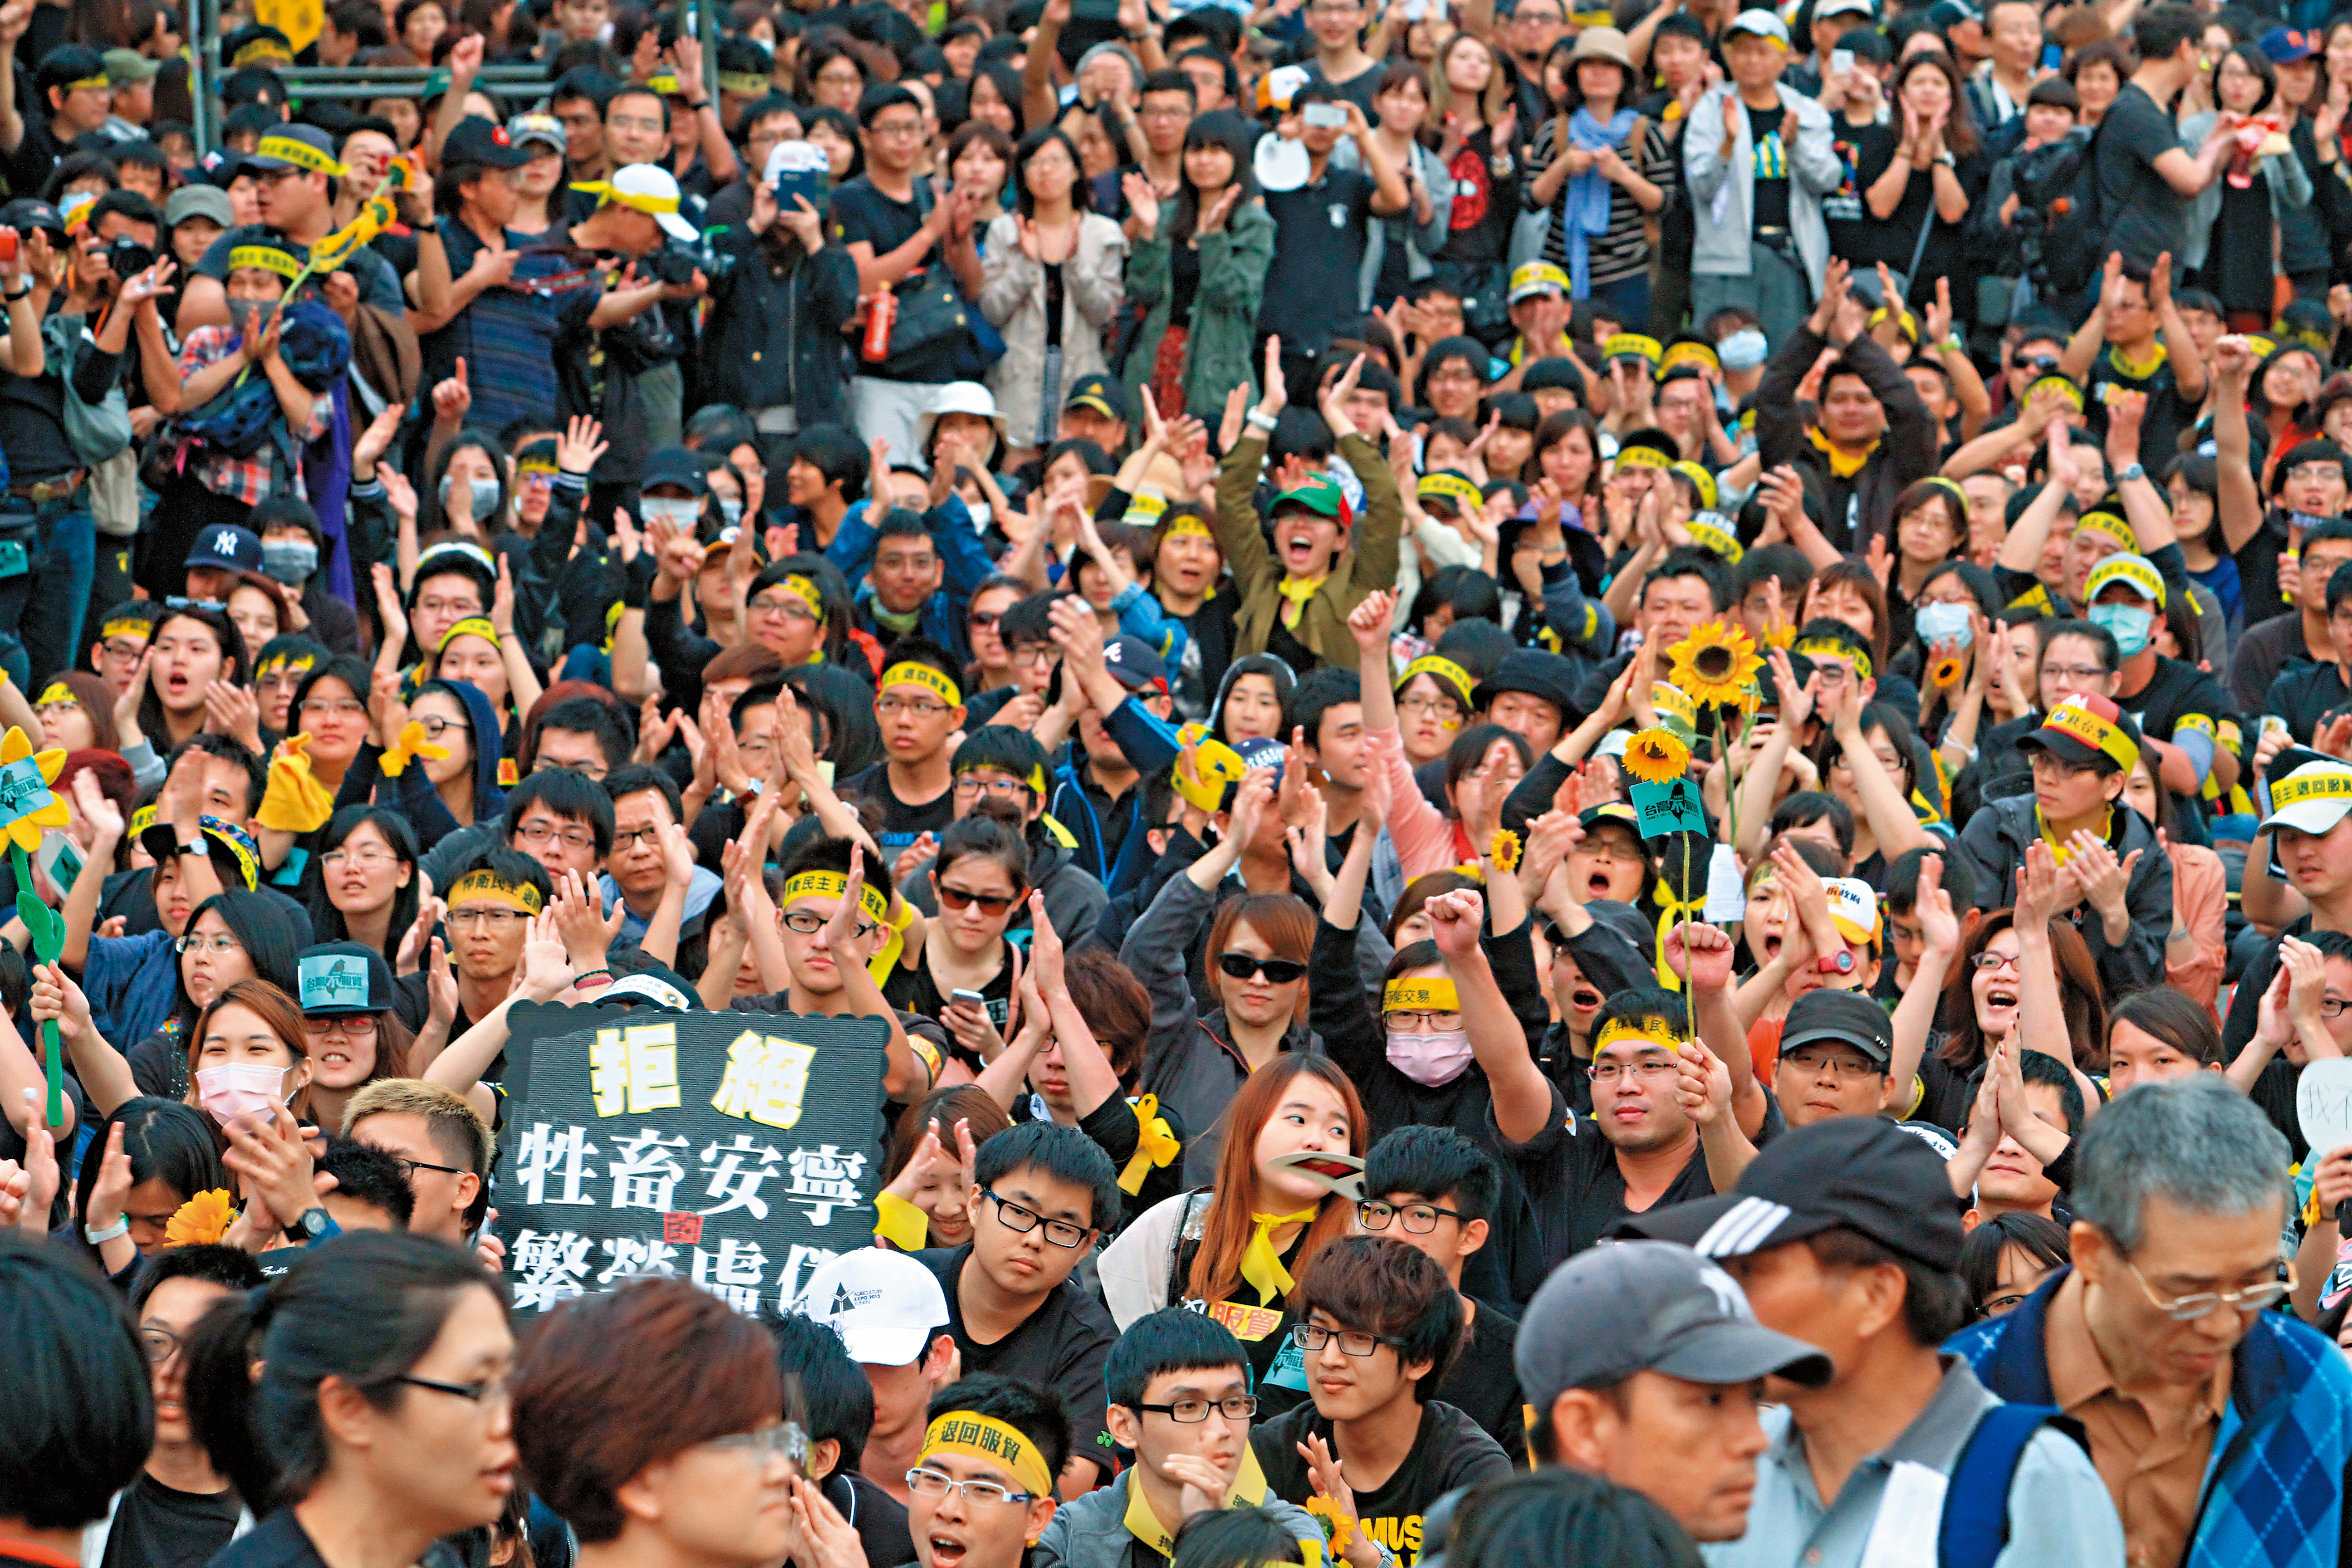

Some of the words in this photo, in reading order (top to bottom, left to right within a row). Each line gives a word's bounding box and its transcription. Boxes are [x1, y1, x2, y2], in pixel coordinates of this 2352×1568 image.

[589, 1023, 817, 1130] 拒絕
[516, 1122, 868, 1227] 牲畜安寧
[666, 1213, 703, 1244] 的
[1209, 1303, 1279, 1338] 服貿
[939, 1420, 1020, 1465] 退回服貿
[1360, 1514, 1428, 1552] MUS
